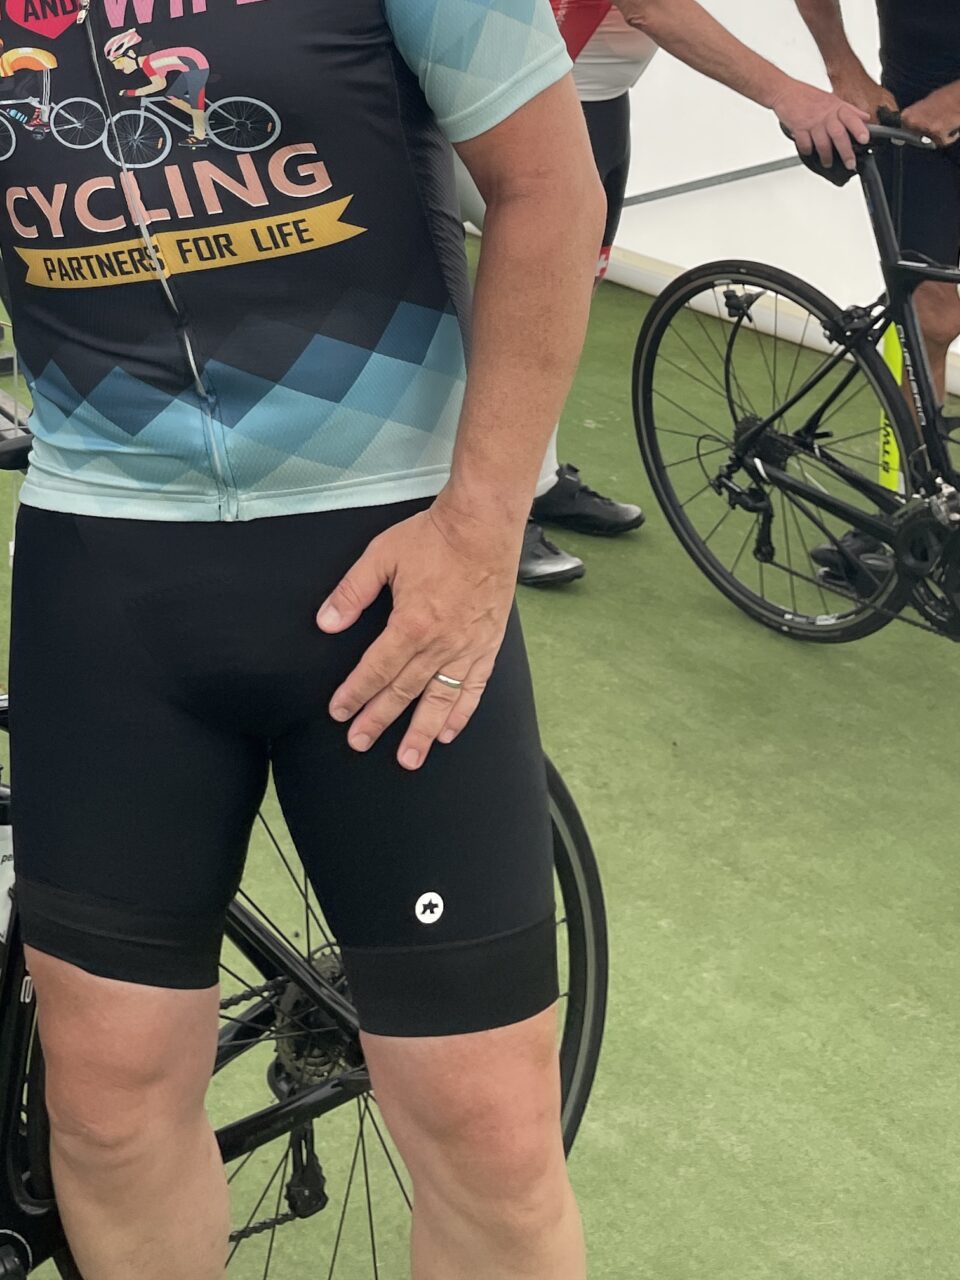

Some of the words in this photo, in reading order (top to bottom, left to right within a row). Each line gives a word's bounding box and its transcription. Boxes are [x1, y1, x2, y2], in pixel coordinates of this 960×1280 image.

[6, 142, 333, 239] CYCLING
[44, 239, 165, 283] PARTNERS
[176, 232, 238, 264] FOR
[254, 218, 315, 254] LIFE
